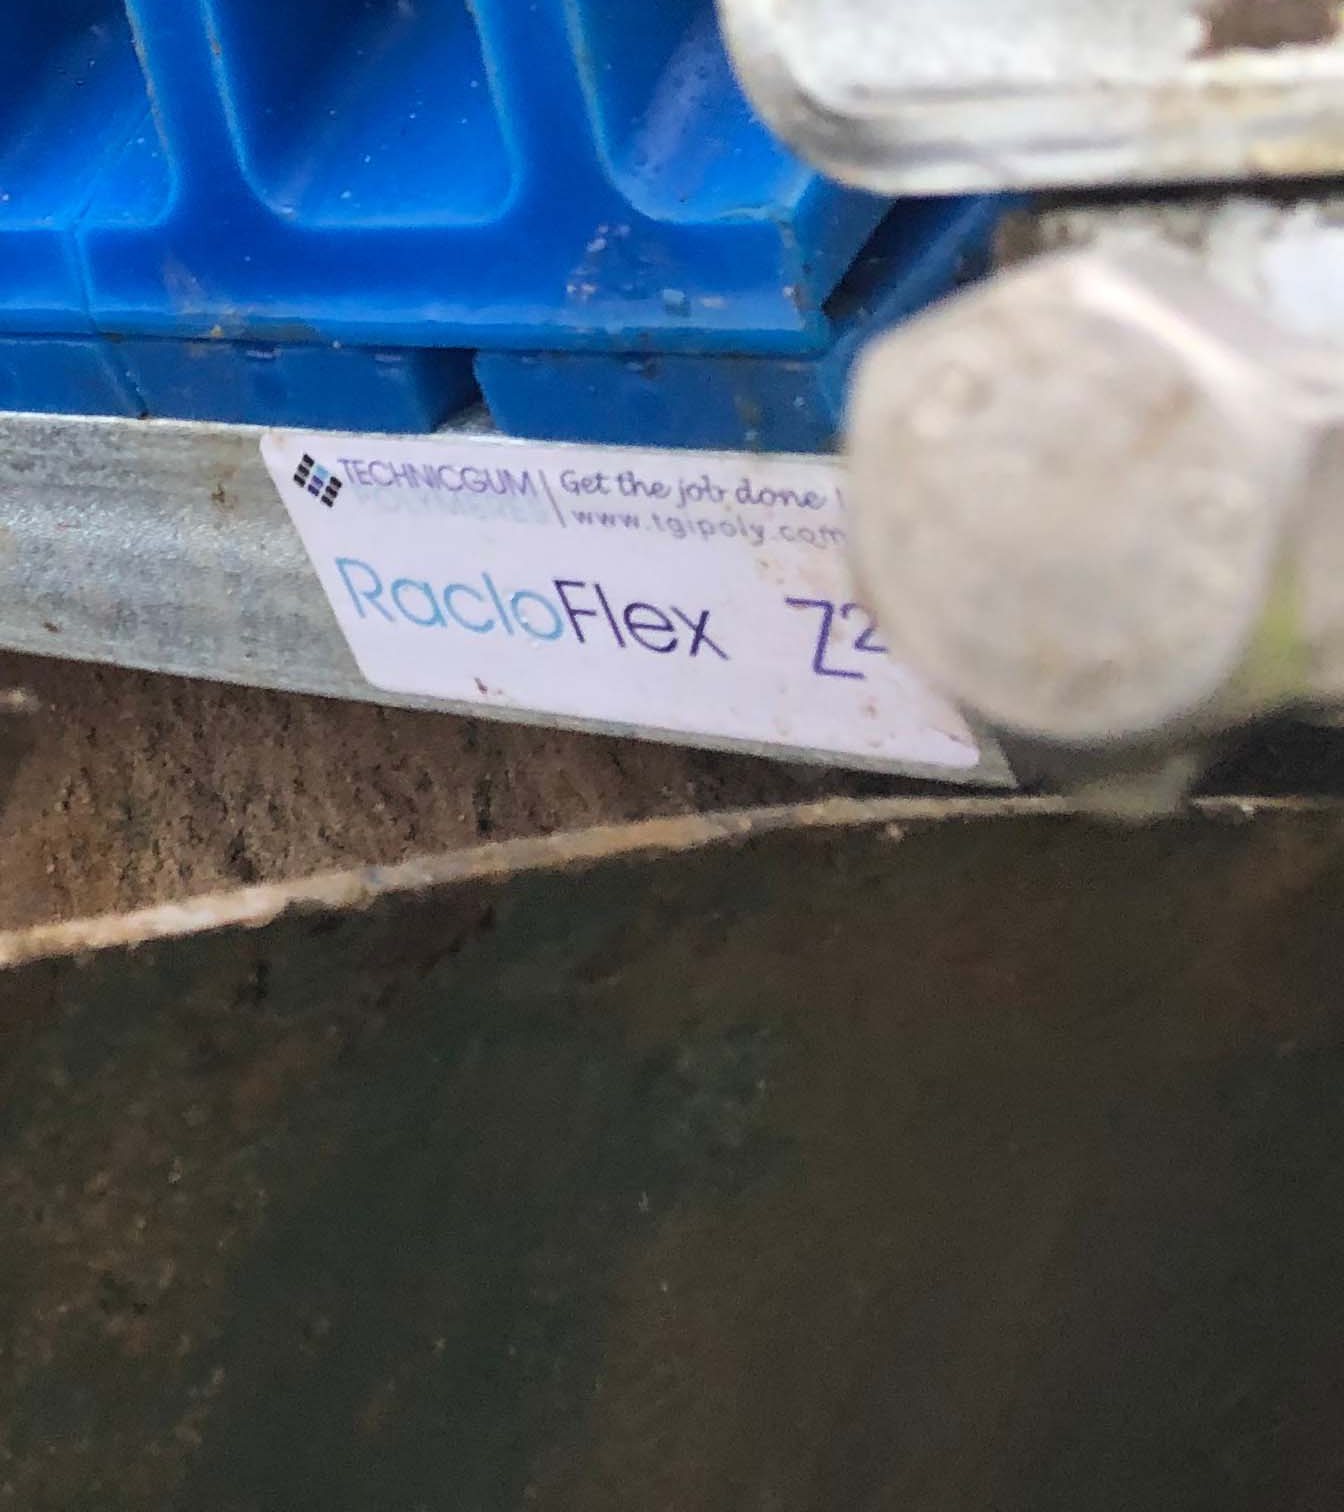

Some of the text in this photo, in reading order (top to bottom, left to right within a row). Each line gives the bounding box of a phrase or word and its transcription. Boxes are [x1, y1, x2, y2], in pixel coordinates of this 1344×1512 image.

[336, 456, 538, 497] TECHNICGUM
[560, 469, 610, 497] Get
[616, 470, 672, 499] the
[676, 474, 727, 509] job
[735, 478, 827, 511] done
[334, 557, 730, 661] RacloFlex
